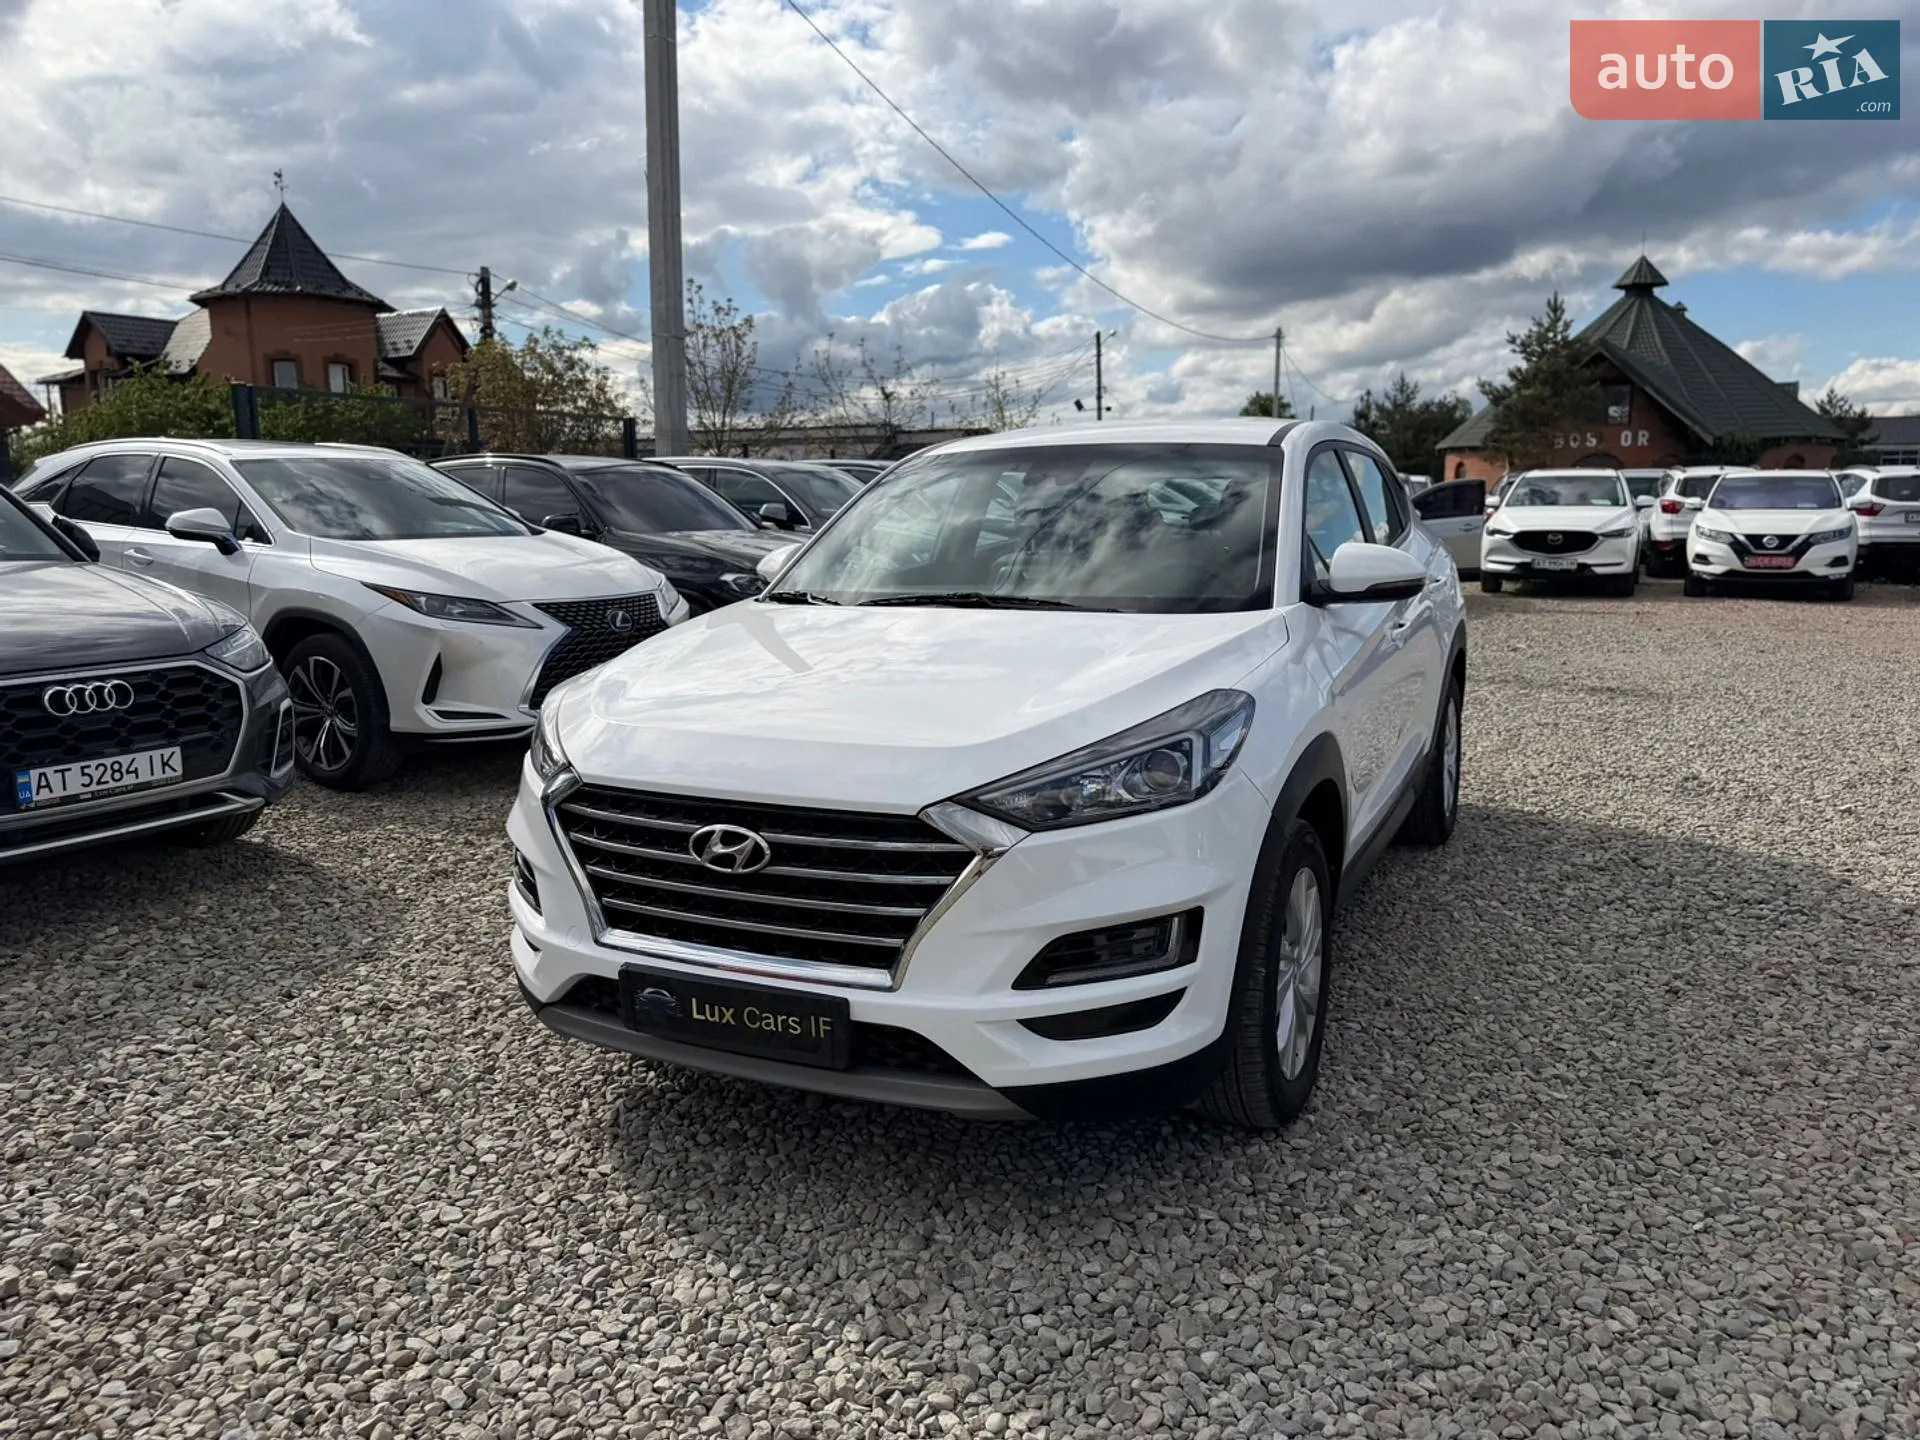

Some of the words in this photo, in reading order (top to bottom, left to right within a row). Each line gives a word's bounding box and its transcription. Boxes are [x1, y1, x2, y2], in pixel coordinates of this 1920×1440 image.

[18, 791, 31, 800] UA
[35, 767, 72, 796] AT
[80, 757, 140, 788] 5284
[691, 997, 736, 1026] Lux
[743, 1006, 802, 1035] Cars
[809, 1015, 835, 1039] IF
